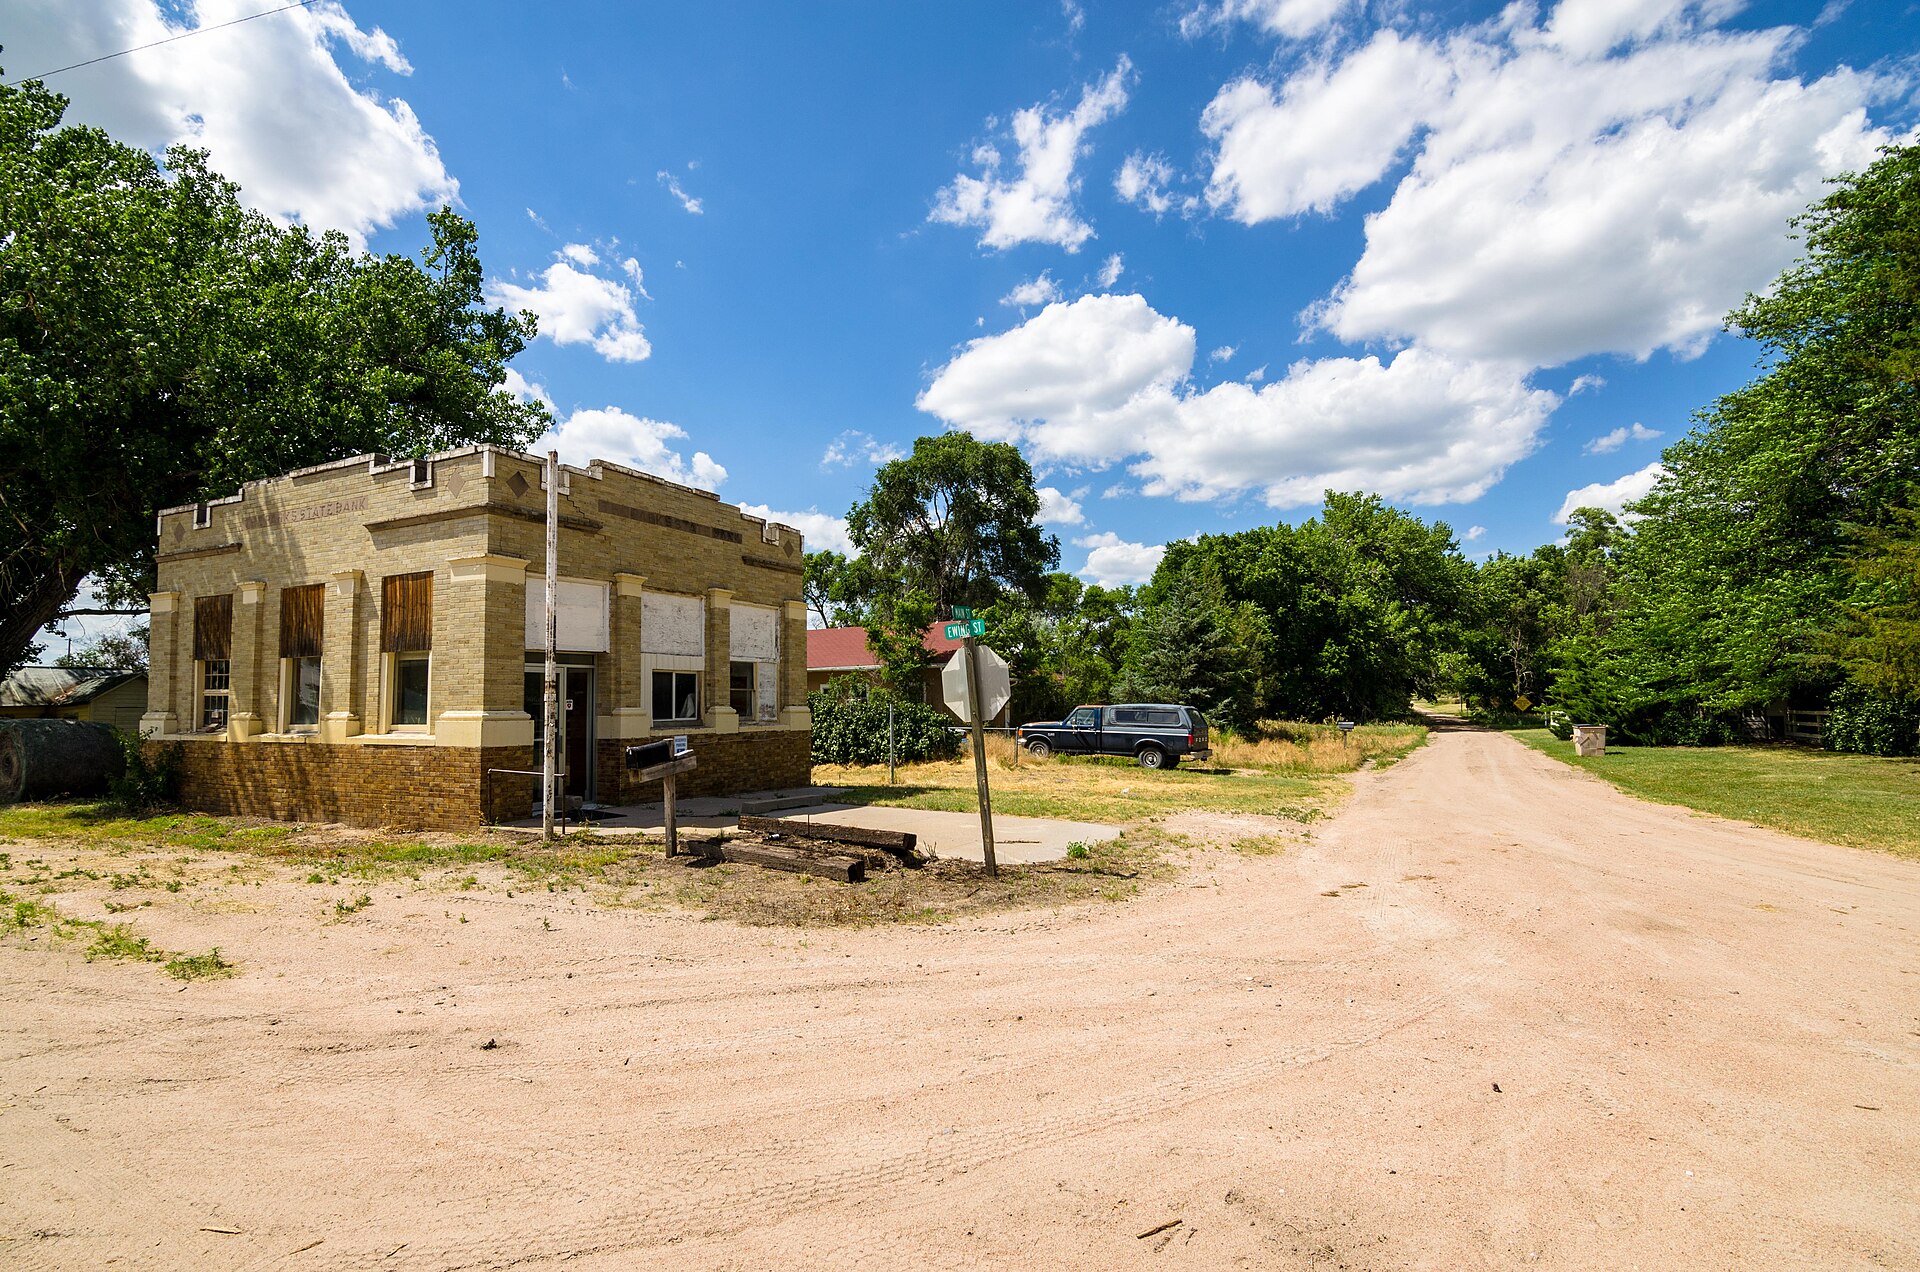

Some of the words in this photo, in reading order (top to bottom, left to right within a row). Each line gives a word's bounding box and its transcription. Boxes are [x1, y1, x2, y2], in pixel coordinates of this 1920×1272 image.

[300, 503, 333, 520] STATE
[335, 497, 366, 514] BANK
[947, 623, 970, 638] EWING
[973, 621, 982, 633] ST
